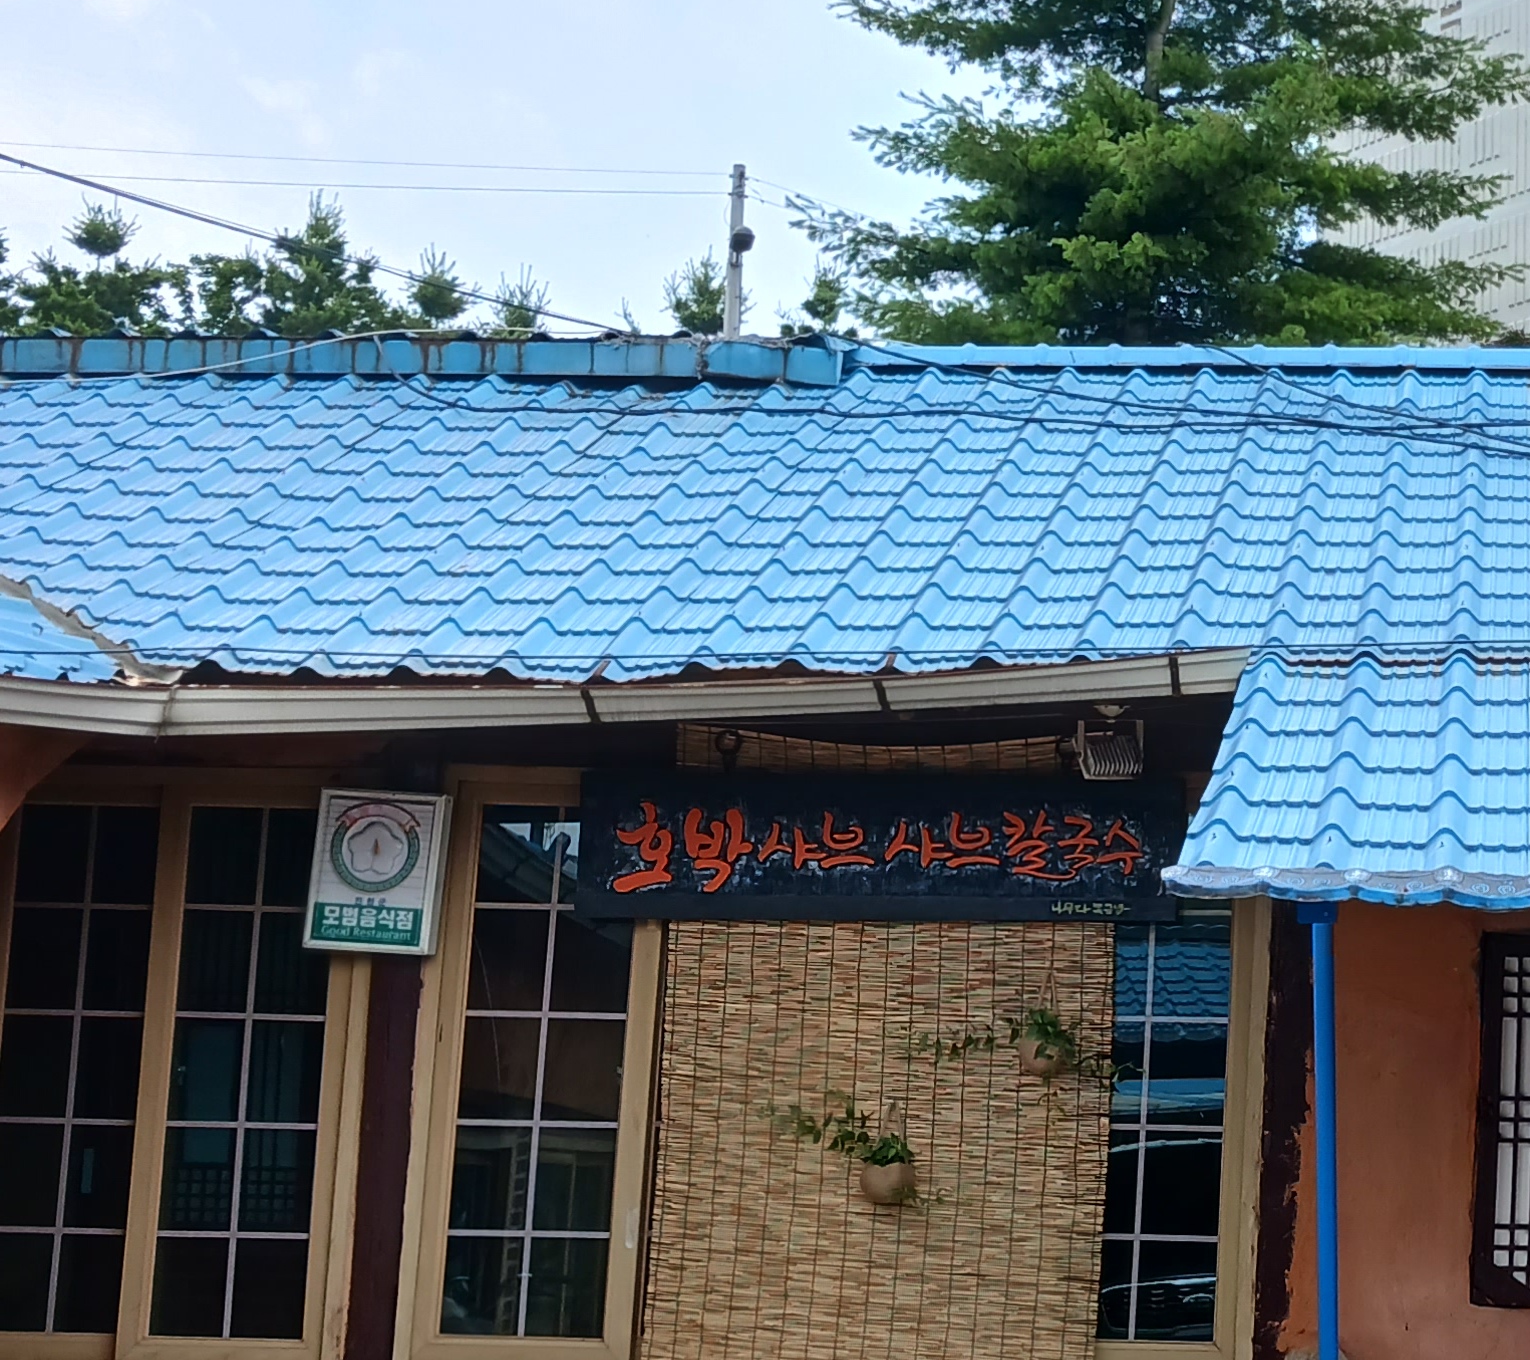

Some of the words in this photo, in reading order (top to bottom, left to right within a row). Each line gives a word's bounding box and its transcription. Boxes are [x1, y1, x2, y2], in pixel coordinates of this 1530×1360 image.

[322, 905, 414, 931] 모범음식점
[321, 925, 350, 938] Good
[352, 926, 412, 941] Restaurant
